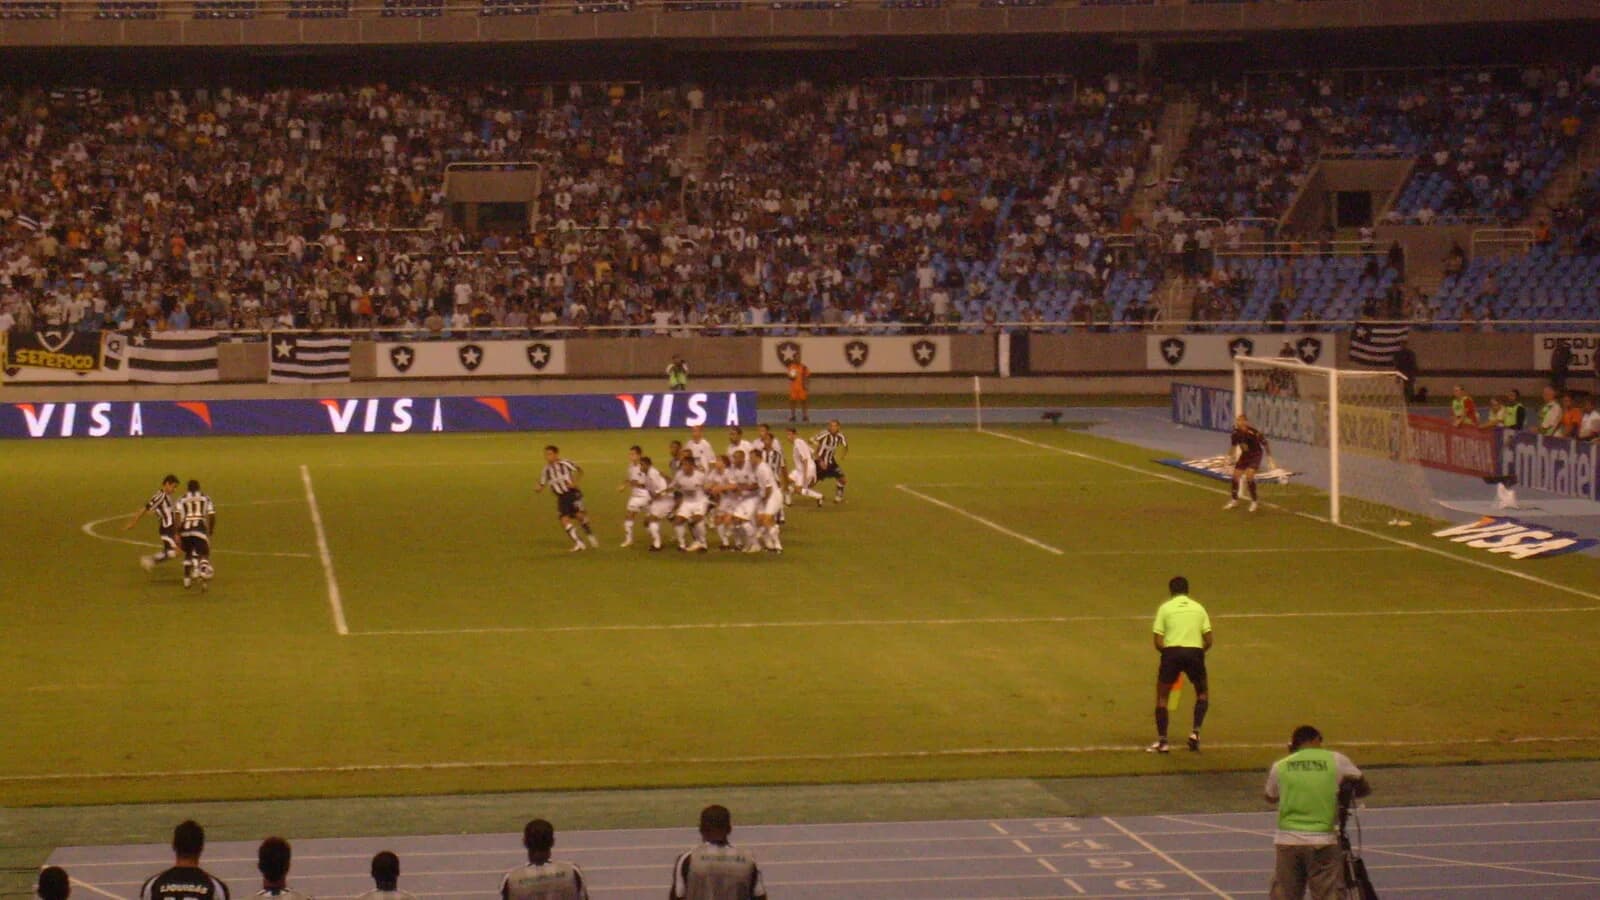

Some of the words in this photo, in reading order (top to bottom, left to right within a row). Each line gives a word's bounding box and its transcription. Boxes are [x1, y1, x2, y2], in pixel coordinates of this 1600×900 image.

[16, 350, 94, 369] SEPEFOGO
[16, 402, 144, 437] VISA
[319, 397, 443, 432] VISA
[615, 393, 739, 427] VISA
[1432, 516, 1577, 560] VISA
